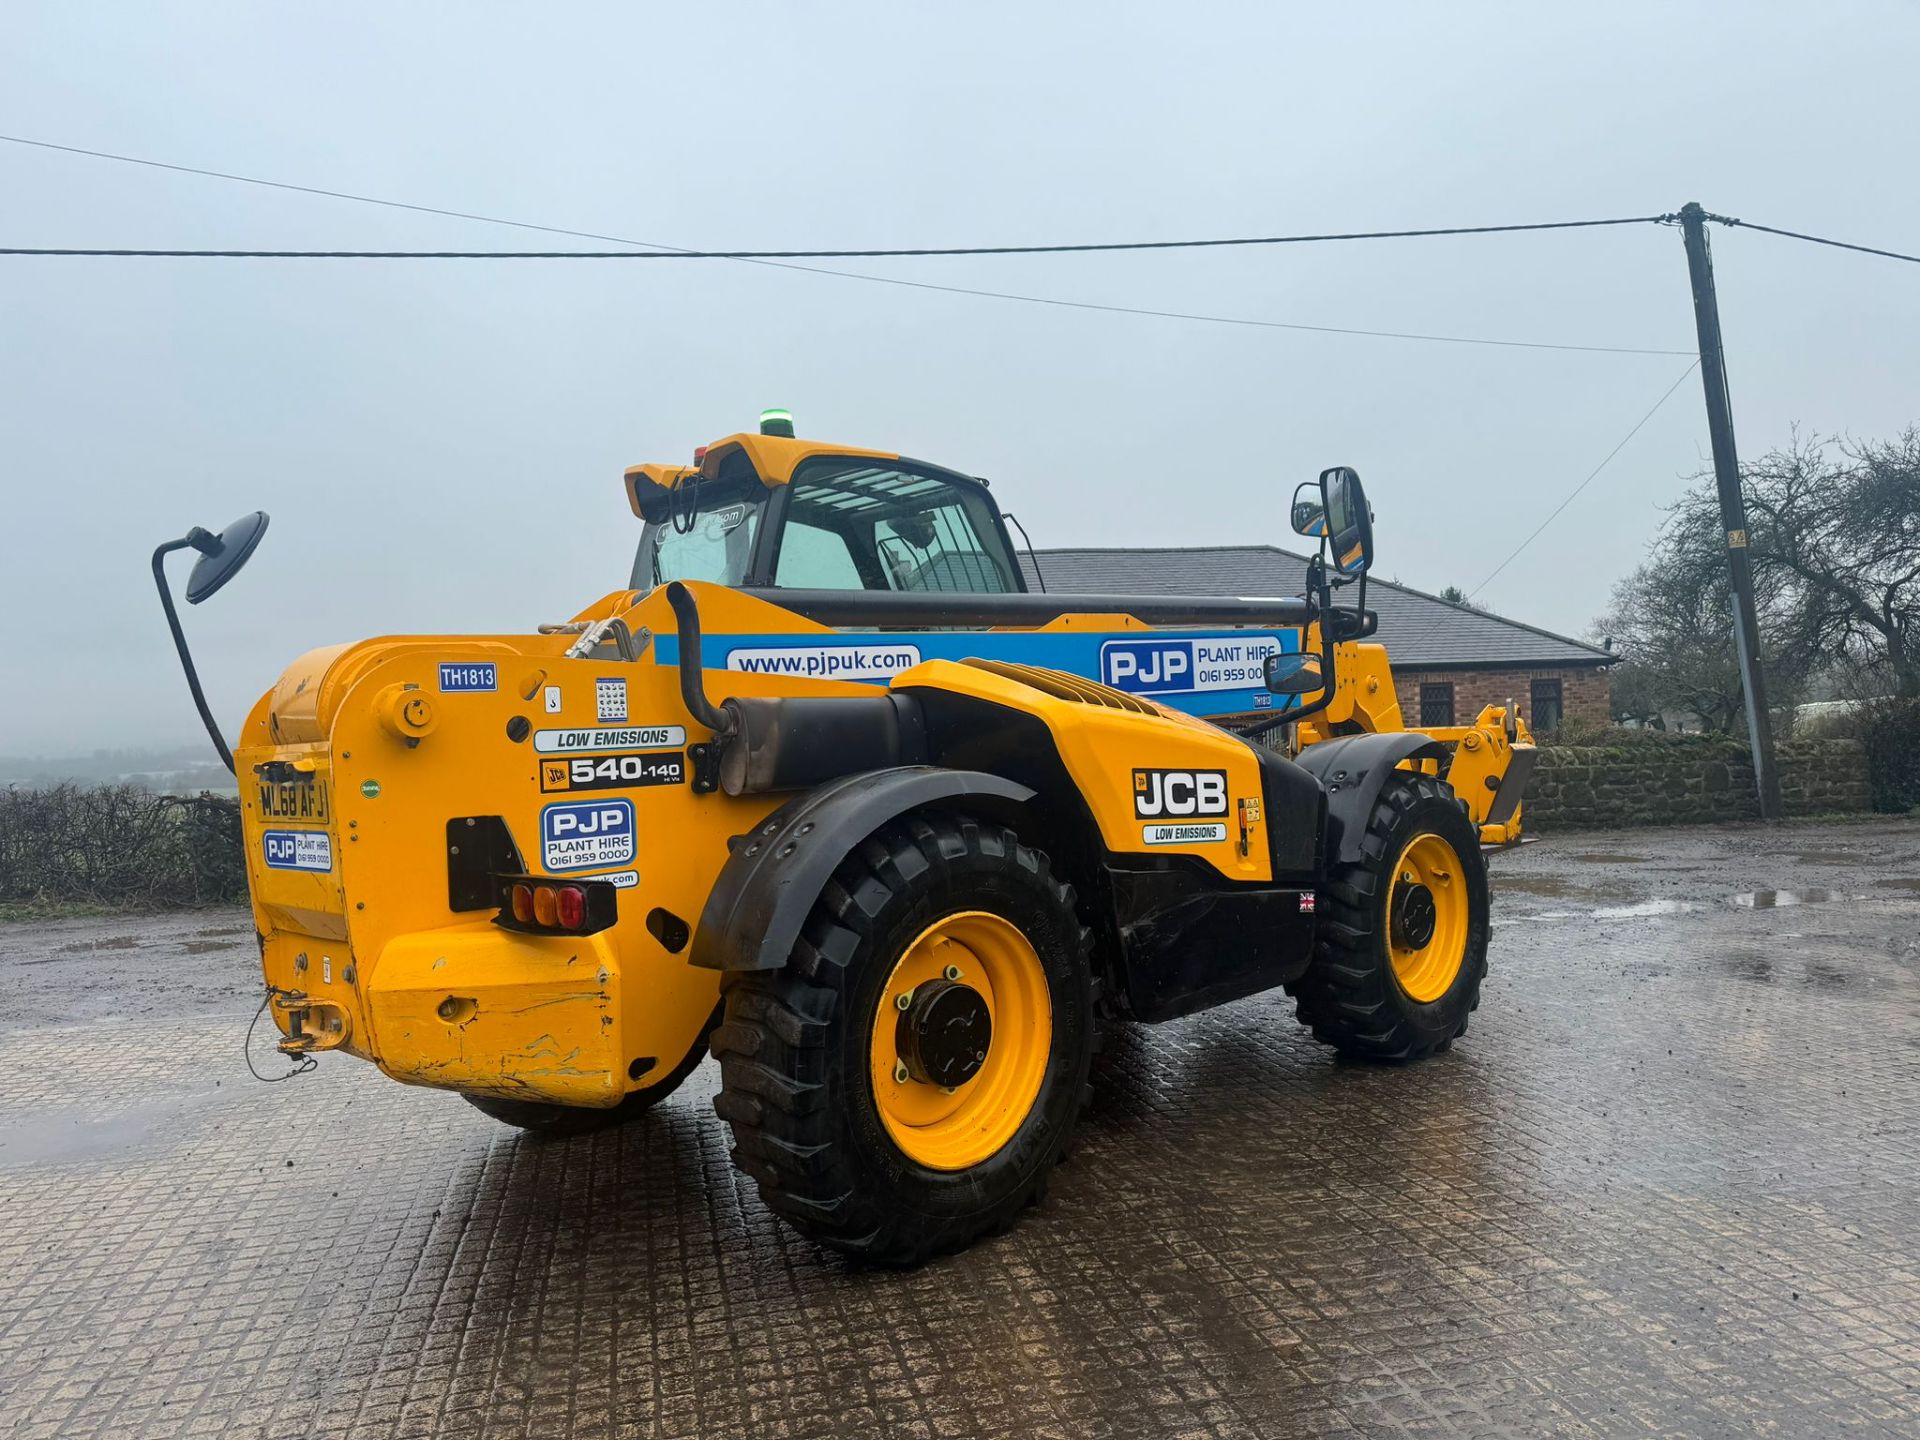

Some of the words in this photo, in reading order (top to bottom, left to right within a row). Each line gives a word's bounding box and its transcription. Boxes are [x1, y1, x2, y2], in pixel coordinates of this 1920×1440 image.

[738, 651, 912, 675] www.pjpuk.com
[1198, 647, 1242, 663] PLANT
[1109, 650, 1188, 684] PJP
[1199, 669, 1221, 683] 0161
[1224, 668, 1245, 681] 959
[1247, 667, 1263, 680] 00
[441, 669, 494, 685] TH1813
[557, 733, 590, 748] LOW
[594, 730, 669, 746] EMISSIONS
[571, 757, 680, 783] 540-140
[1136, 772, 1227, 815] JCB
[553, 809, 623, 836] PJP
[1155, 828, 1173, 840] LOW
[1175, 826, 1217, 839] EMISSIONS
[268, 839, 295, 859] PJP
[297, 839, 315, 850] PLANT
[316, 841, 328, 851] HIRE
[548, 839, 594, 854] PLANT
[598, 836, 629, 849] HIRE
[550, 855, 572, 866] 0161
[574, 852, 596, 863] 959
[598, 849, 629, 860] 0000
